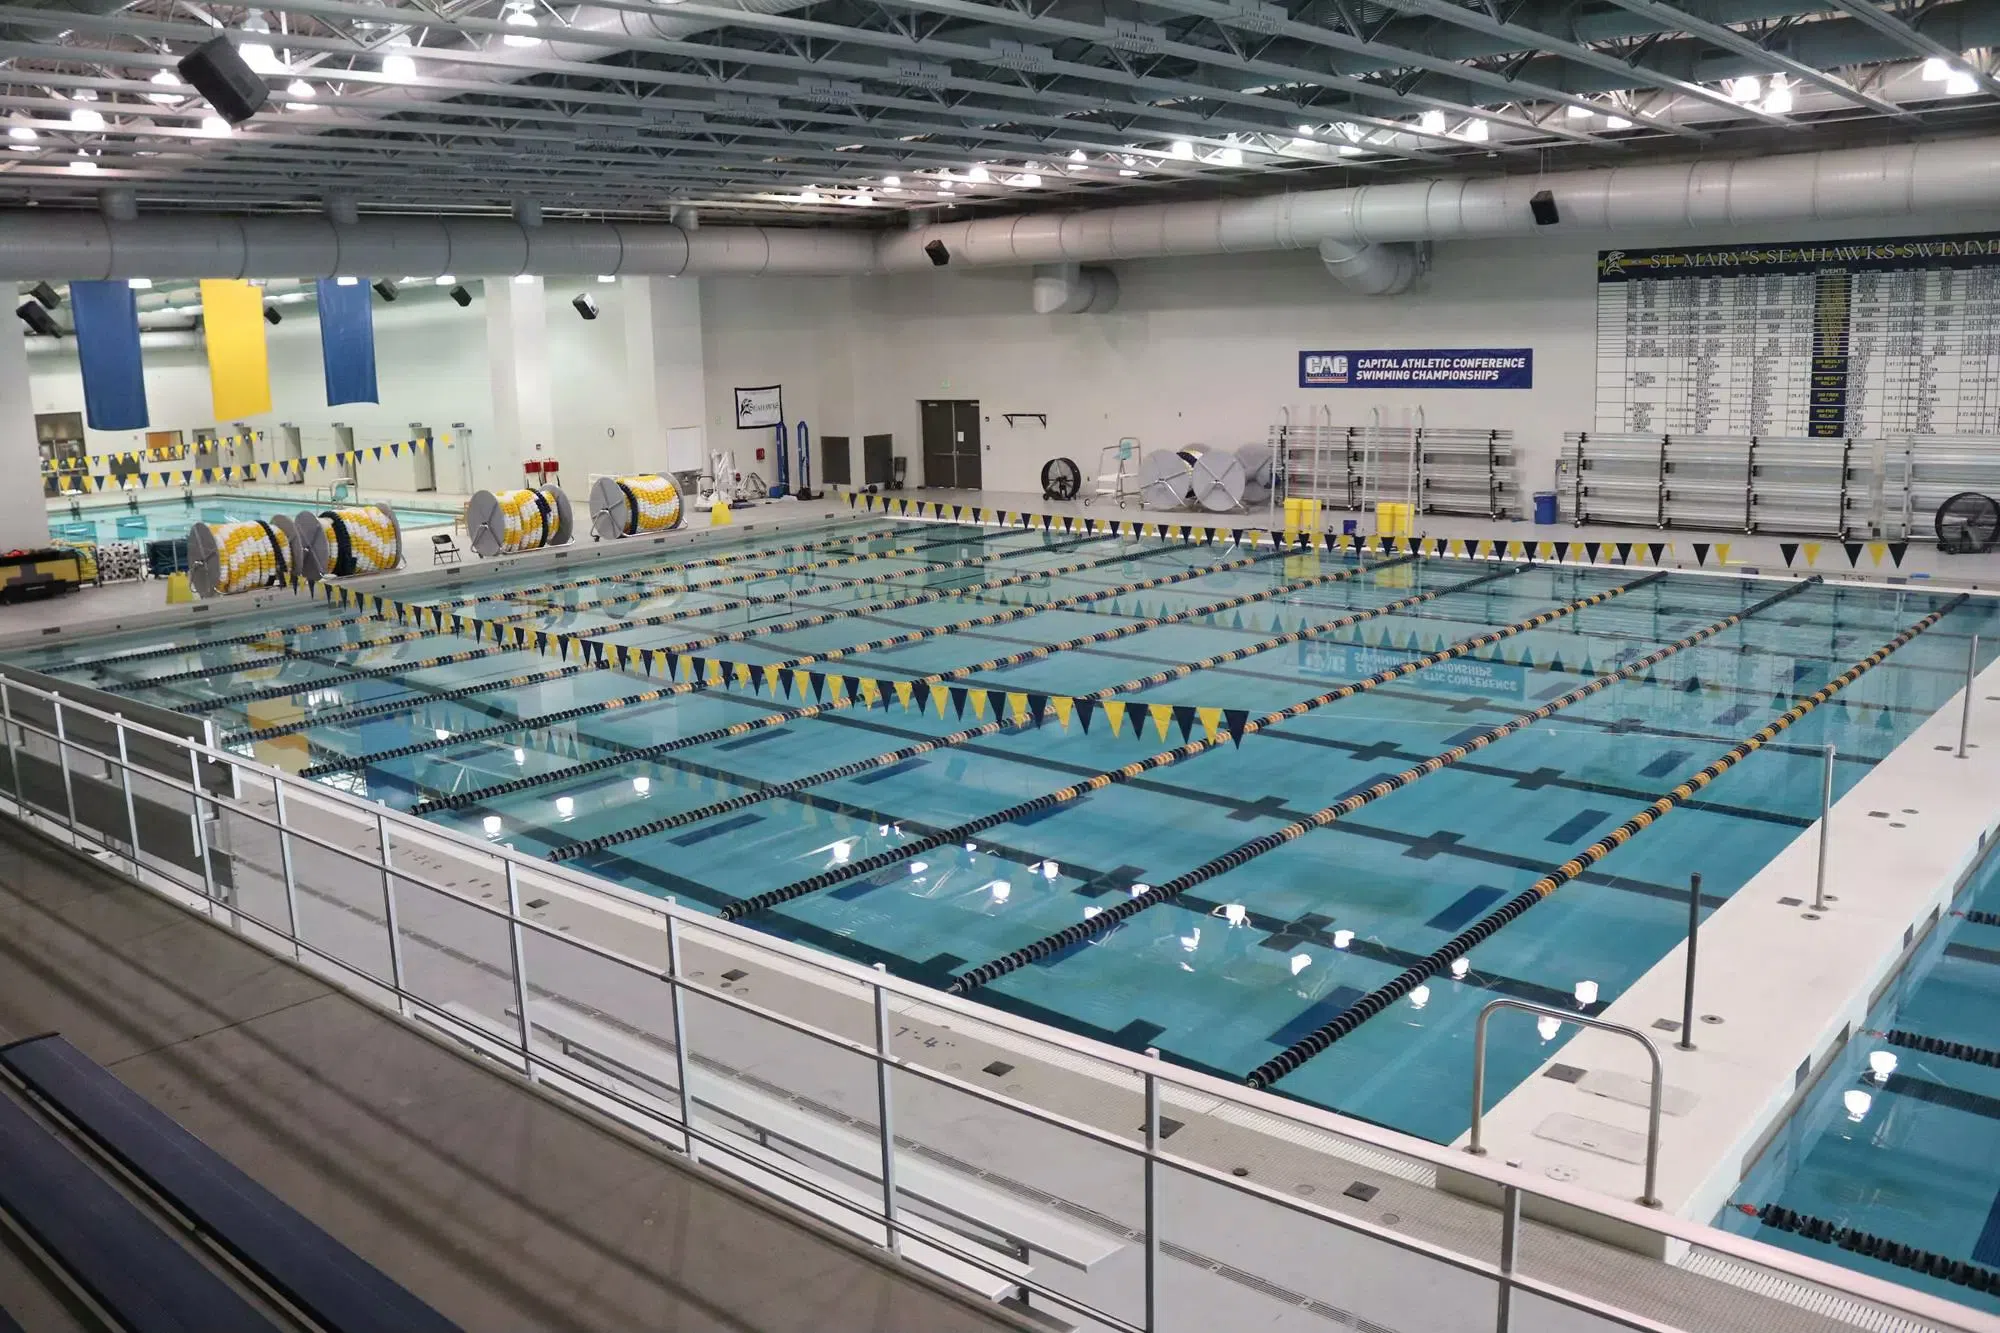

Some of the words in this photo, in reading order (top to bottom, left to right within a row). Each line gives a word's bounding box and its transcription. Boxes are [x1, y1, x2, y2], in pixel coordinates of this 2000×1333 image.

[1650, 254, 1677, 269] ST.
[1683, 250, 1760, 267] MARY'S
[1766, 243, 1896, 264] SEAHAWKS
[1305, 355, 1349, 374] CAC
[1358, 358, 1399, 369] CAPITAL
[1400, 358, 1452, 369] ATHLETIC
[1453, 357, 1526, 368] CONFERENCE
[1356, 370, 1411, 381] SWIMMING
[1412, 370, 1500, 381] CHAMPIONSHIPS
